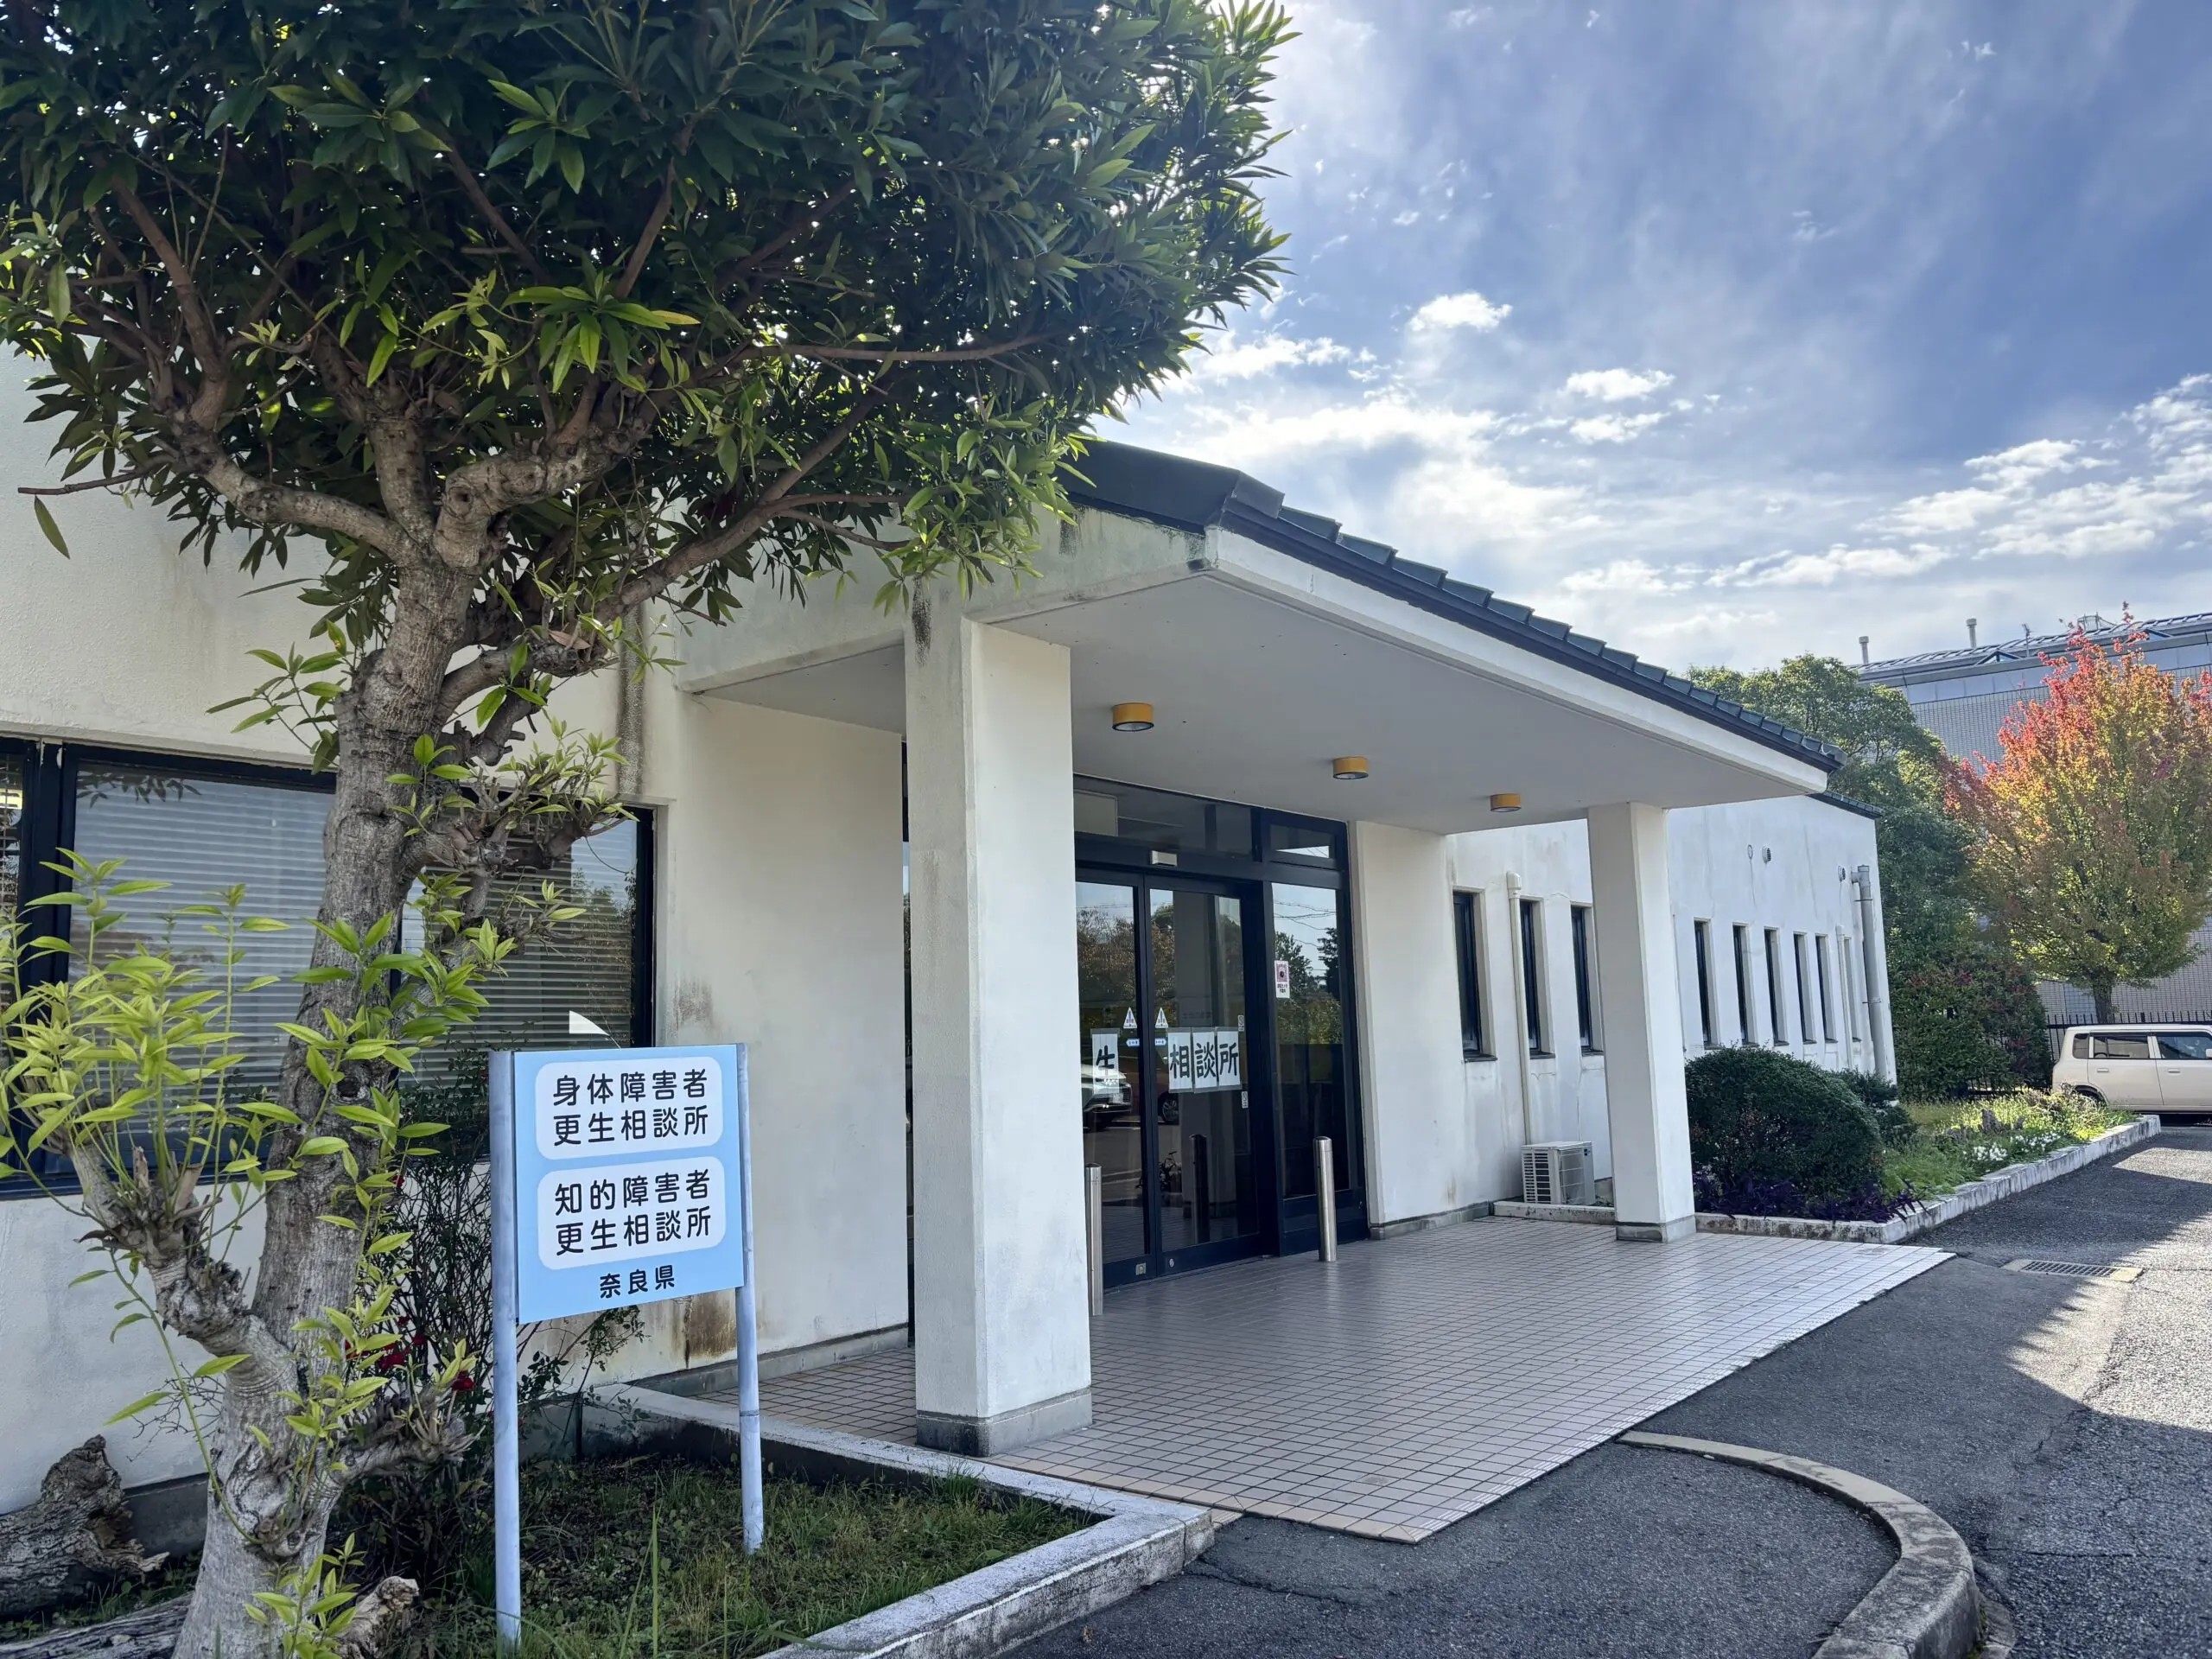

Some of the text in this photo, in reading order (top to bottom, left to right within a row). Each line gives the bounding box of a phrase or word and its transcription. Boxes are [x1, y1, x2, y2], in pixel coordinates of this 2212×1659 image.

[1169, 1042, 1239, 1079] 相談所
[553, 1068, 708, 1107] 身体障害者
[553, 1104, 709, 1147] 更生相談所
[555, 1168, 710, 1216] 知的障害者
[556, 1205, 711, 1256] 更生相談所
[600, 1264, 675, 1299] 奈良県
